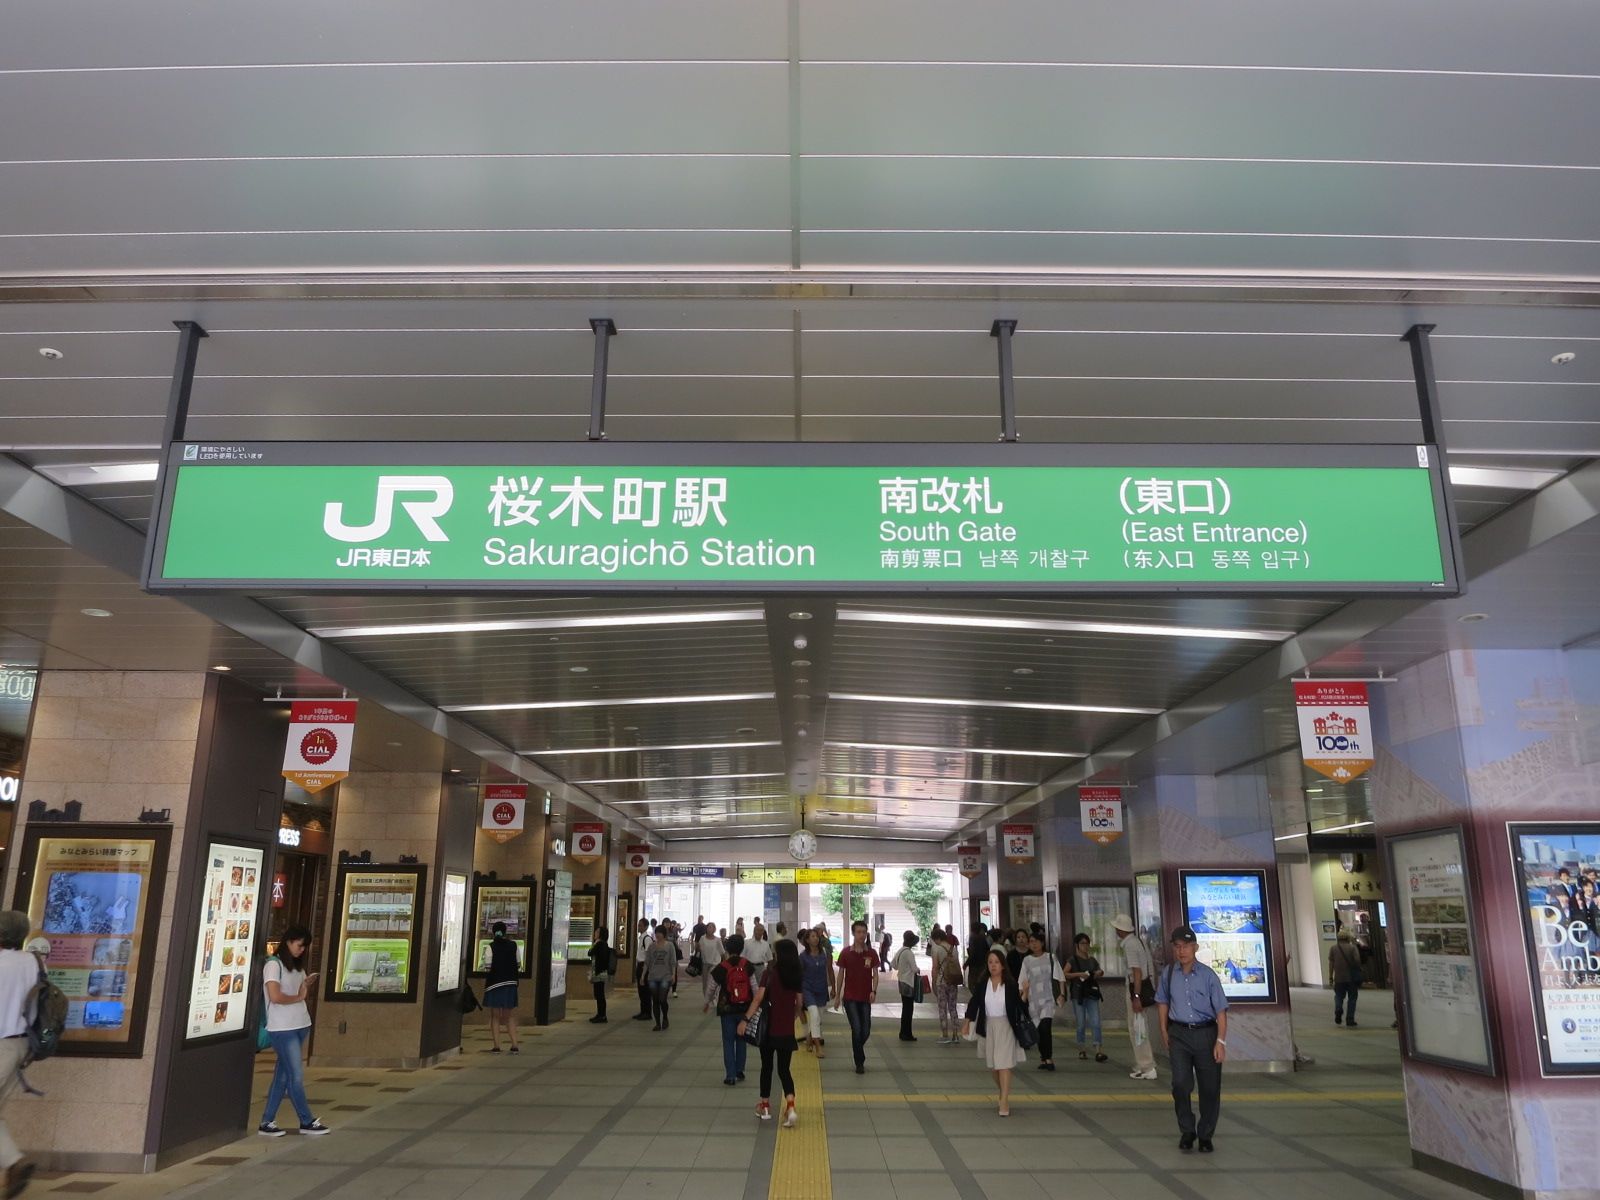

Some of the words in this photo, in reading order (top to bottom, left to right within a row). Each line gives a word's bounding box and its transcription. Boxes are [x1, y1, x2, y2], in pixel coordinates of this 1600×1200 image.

[487, 475, 728, 528] 桜木町駅
[878, 476, 1003, 514] 南改札
[1119, 477, 1231, 516] (東口)
[323, 475, 454, 543] JR
[879, 521, 949, 542] South
[958, 521, 1017, 542] Gate
[1122, 519, 1185, 545] (East
[1192, 519, 1308, 546] Entrance)
[336, 548, 432, 568] JR東日本
[483, 537, 689, 573] Sakuragichō
[701, 537, 815, 567] Station
[880, 549, 963, 569] 南剪票口
[979, 549, 1020, 569] 남쪽
[1029, 549, 1091, 569] 개찰구
[1124, 549, 1194, 569] (东入口
[1211, 550, 1252, 570] 동쪽
[1261, 550, 1310, 570] 입구)
[306, 746, 330, 754] CIAL
[1316, 736, 1360, 751] 100th
[1532, 905, 1589, 948] Be
